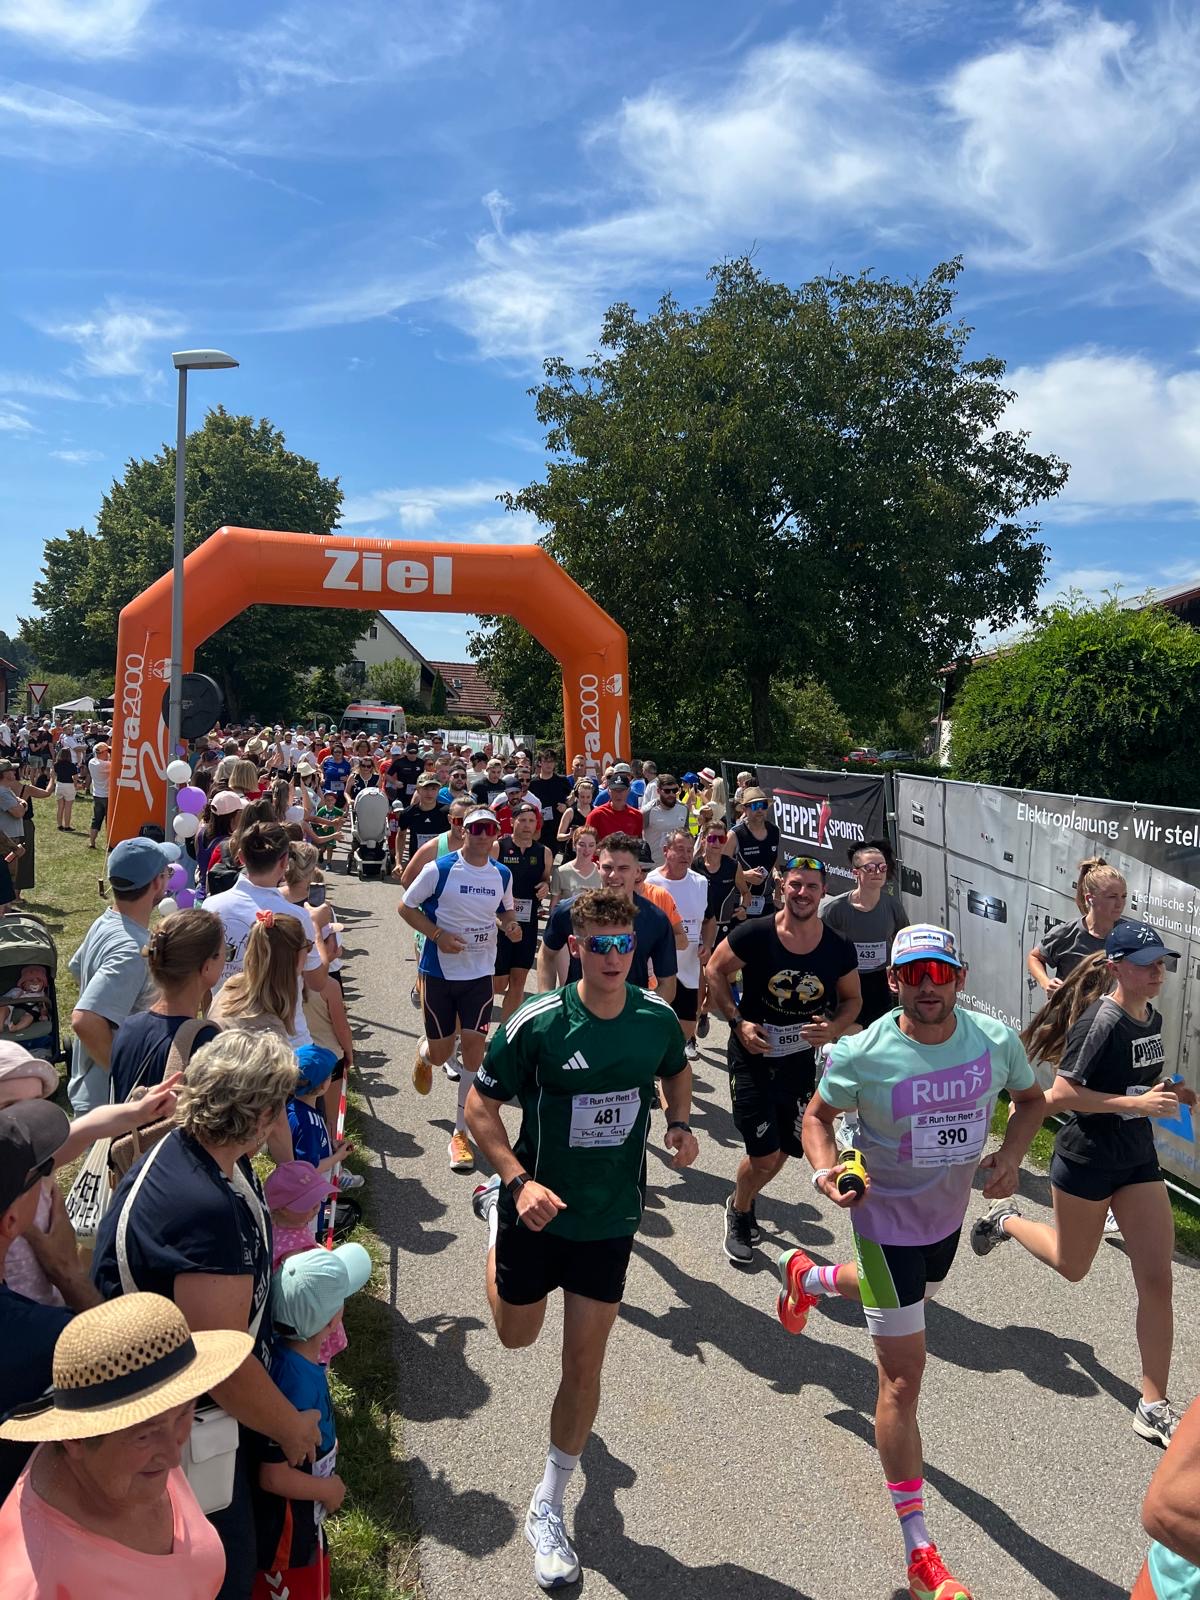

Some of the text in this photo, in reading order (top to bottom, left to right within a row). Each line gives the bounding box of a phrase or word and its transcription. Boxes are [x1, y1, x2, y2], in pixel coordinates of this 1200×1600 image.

[323, 549, 452, 594] Ziel
[829, 819, 864, 842] SPORTS
[1016, 802, 1119, 839] Elektroplanung
[1133, 818, 1161, 842] Wir
[1164, 824, 1200, 849] stel
[1134, 890, 1200, 917] Technische Sy
[1143, 911, 1182, 932] Studium
[474, 933, 488, 942] 782
[972, 995, 991, 1015] GmbH
[991, 1006, 997, 1018] &
[998, 1009, 1010, 1025] Co.
[1010, 1015, 1022, 1031] KG
[778, 1034, 799, 1045] 850
[590, 1097, 604, 1105] Run
[615, 1094, 629, 1102] Rett
[912, 1079, 966, 1105] Run
[594, 1108, 620, 1125] 481
[929, 1112, 973, 1124] Run for Rett
[937, 1127, 967, 1146] 390
